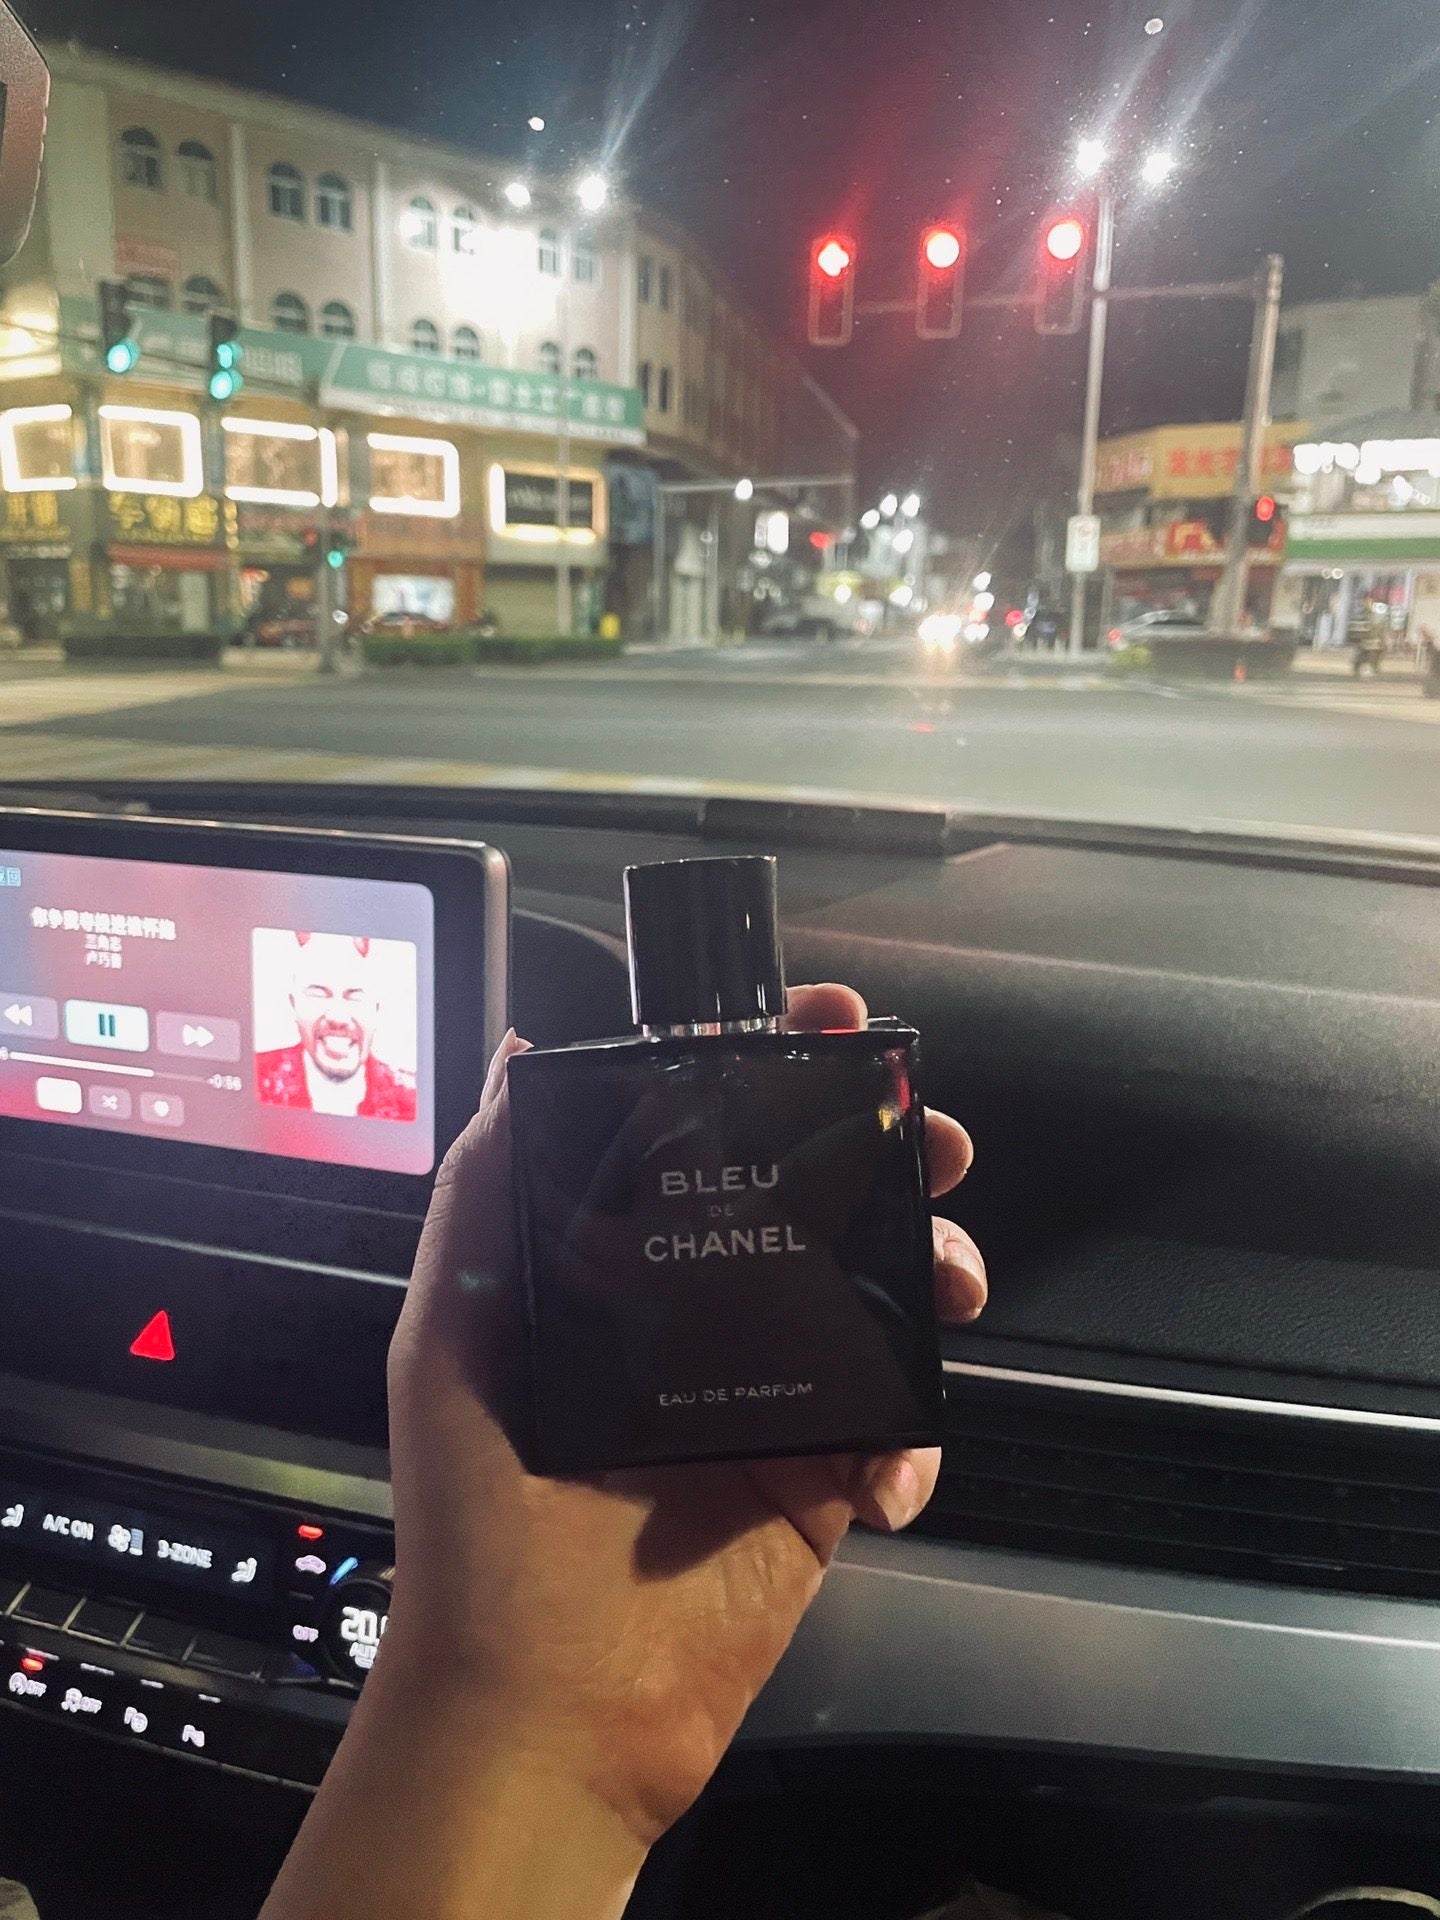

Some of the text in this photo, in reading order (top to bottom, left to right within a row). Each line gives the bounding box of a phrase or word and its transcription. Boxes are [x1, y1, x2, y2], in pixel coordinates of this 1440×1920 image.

[661, 1163, 780, 1196] BLEU
[709, 1204, 736, 1218] DE
[643, 1225, 807, 1262] CHANEL
[659, 1383, 813, 1407] EAU DE PARFUM
[42, 1513, 94, 1541] A/C ON
